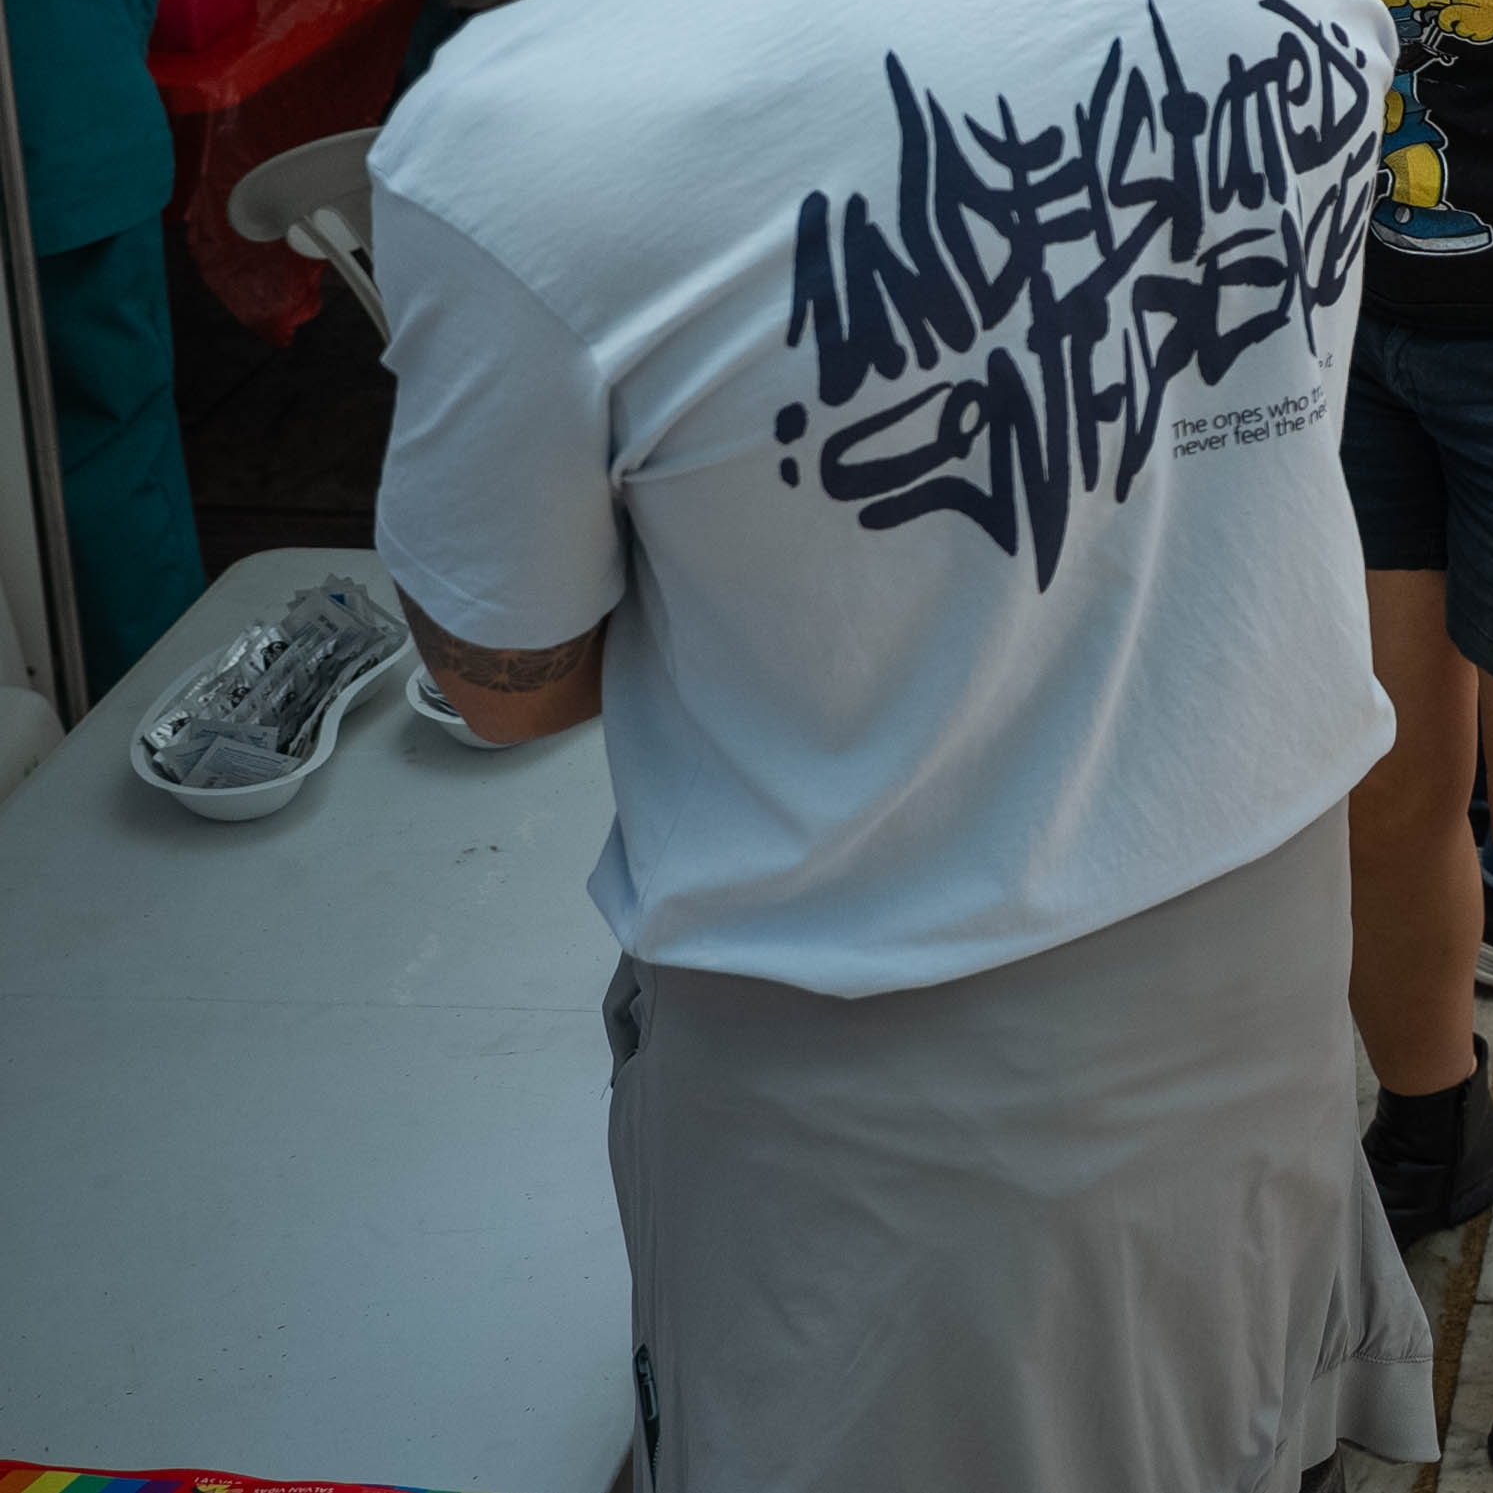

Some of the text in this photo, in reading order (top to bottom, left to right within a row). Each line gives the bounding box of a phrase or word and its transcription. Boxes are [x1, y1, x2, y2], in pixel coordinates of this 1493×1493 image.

[1172, 418, 1207, 440] The
[1213, 407, 1263, 431] ones
[1268, 395, 1309, 419] who
[1173, 433, 1228, 459] never
[1233, 422, 1270, 445] feel
[1275, 417, 1306, 437] the
